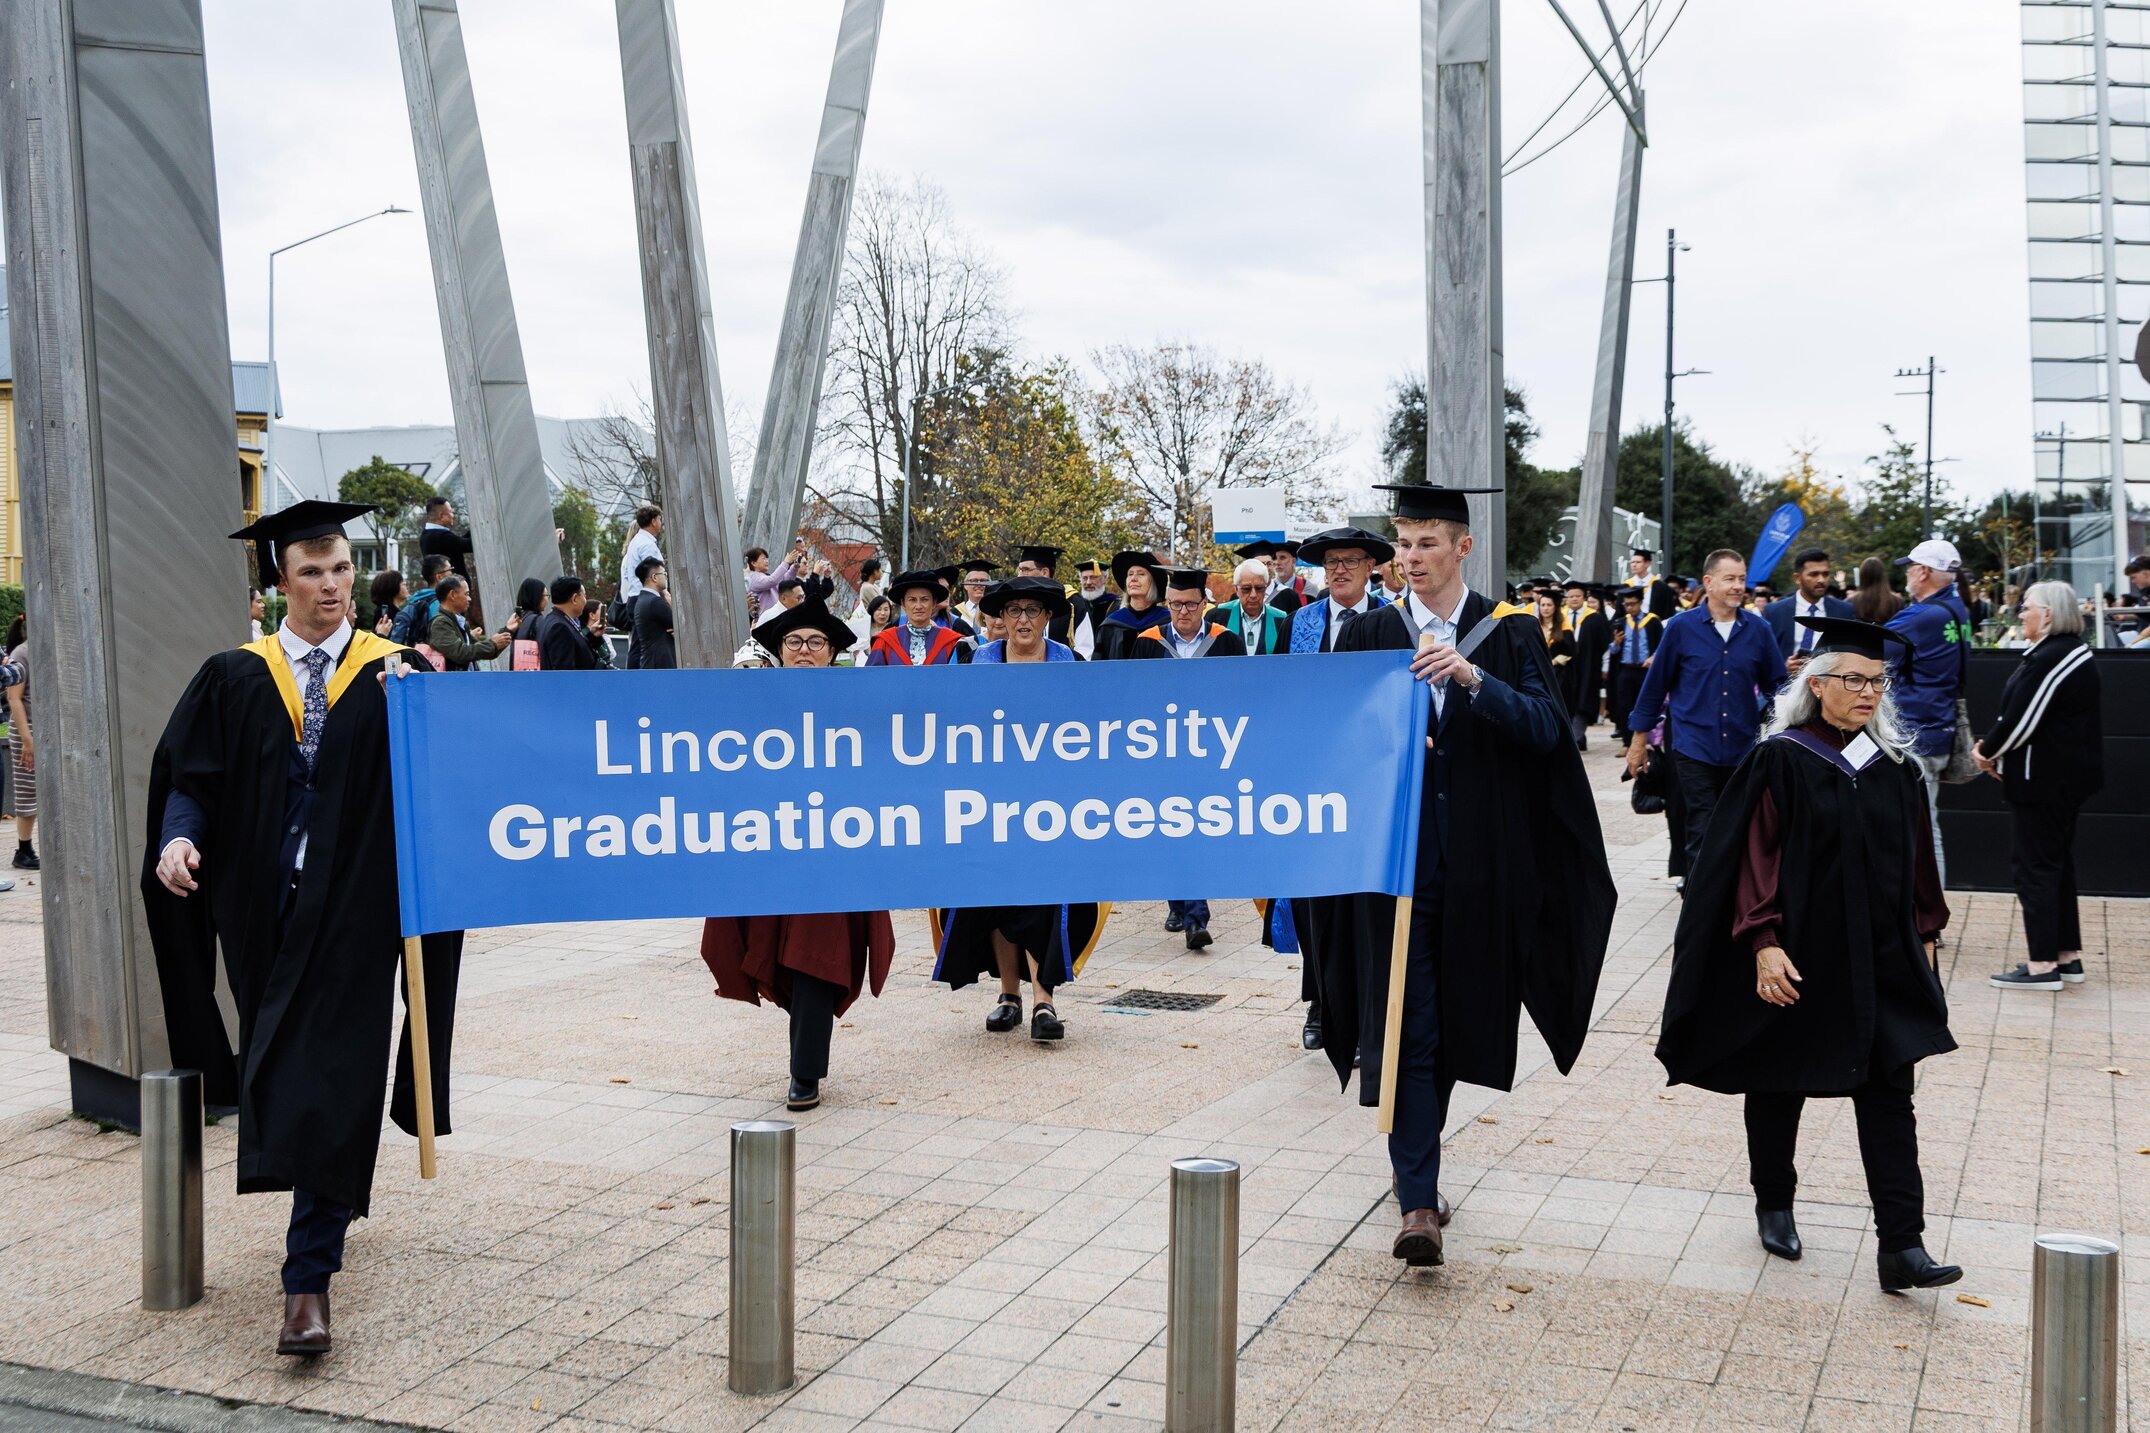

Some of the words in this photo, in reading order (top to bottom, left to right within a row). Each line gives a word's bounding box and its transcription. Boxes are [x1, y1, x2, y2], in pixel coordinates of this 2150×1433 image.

[595, 712, 862, 775] Lincoln
[891, 703, 1249, 769] University
[489, 791, 921, 860] Graduation
[944, 778, 1348, 844] Procession
